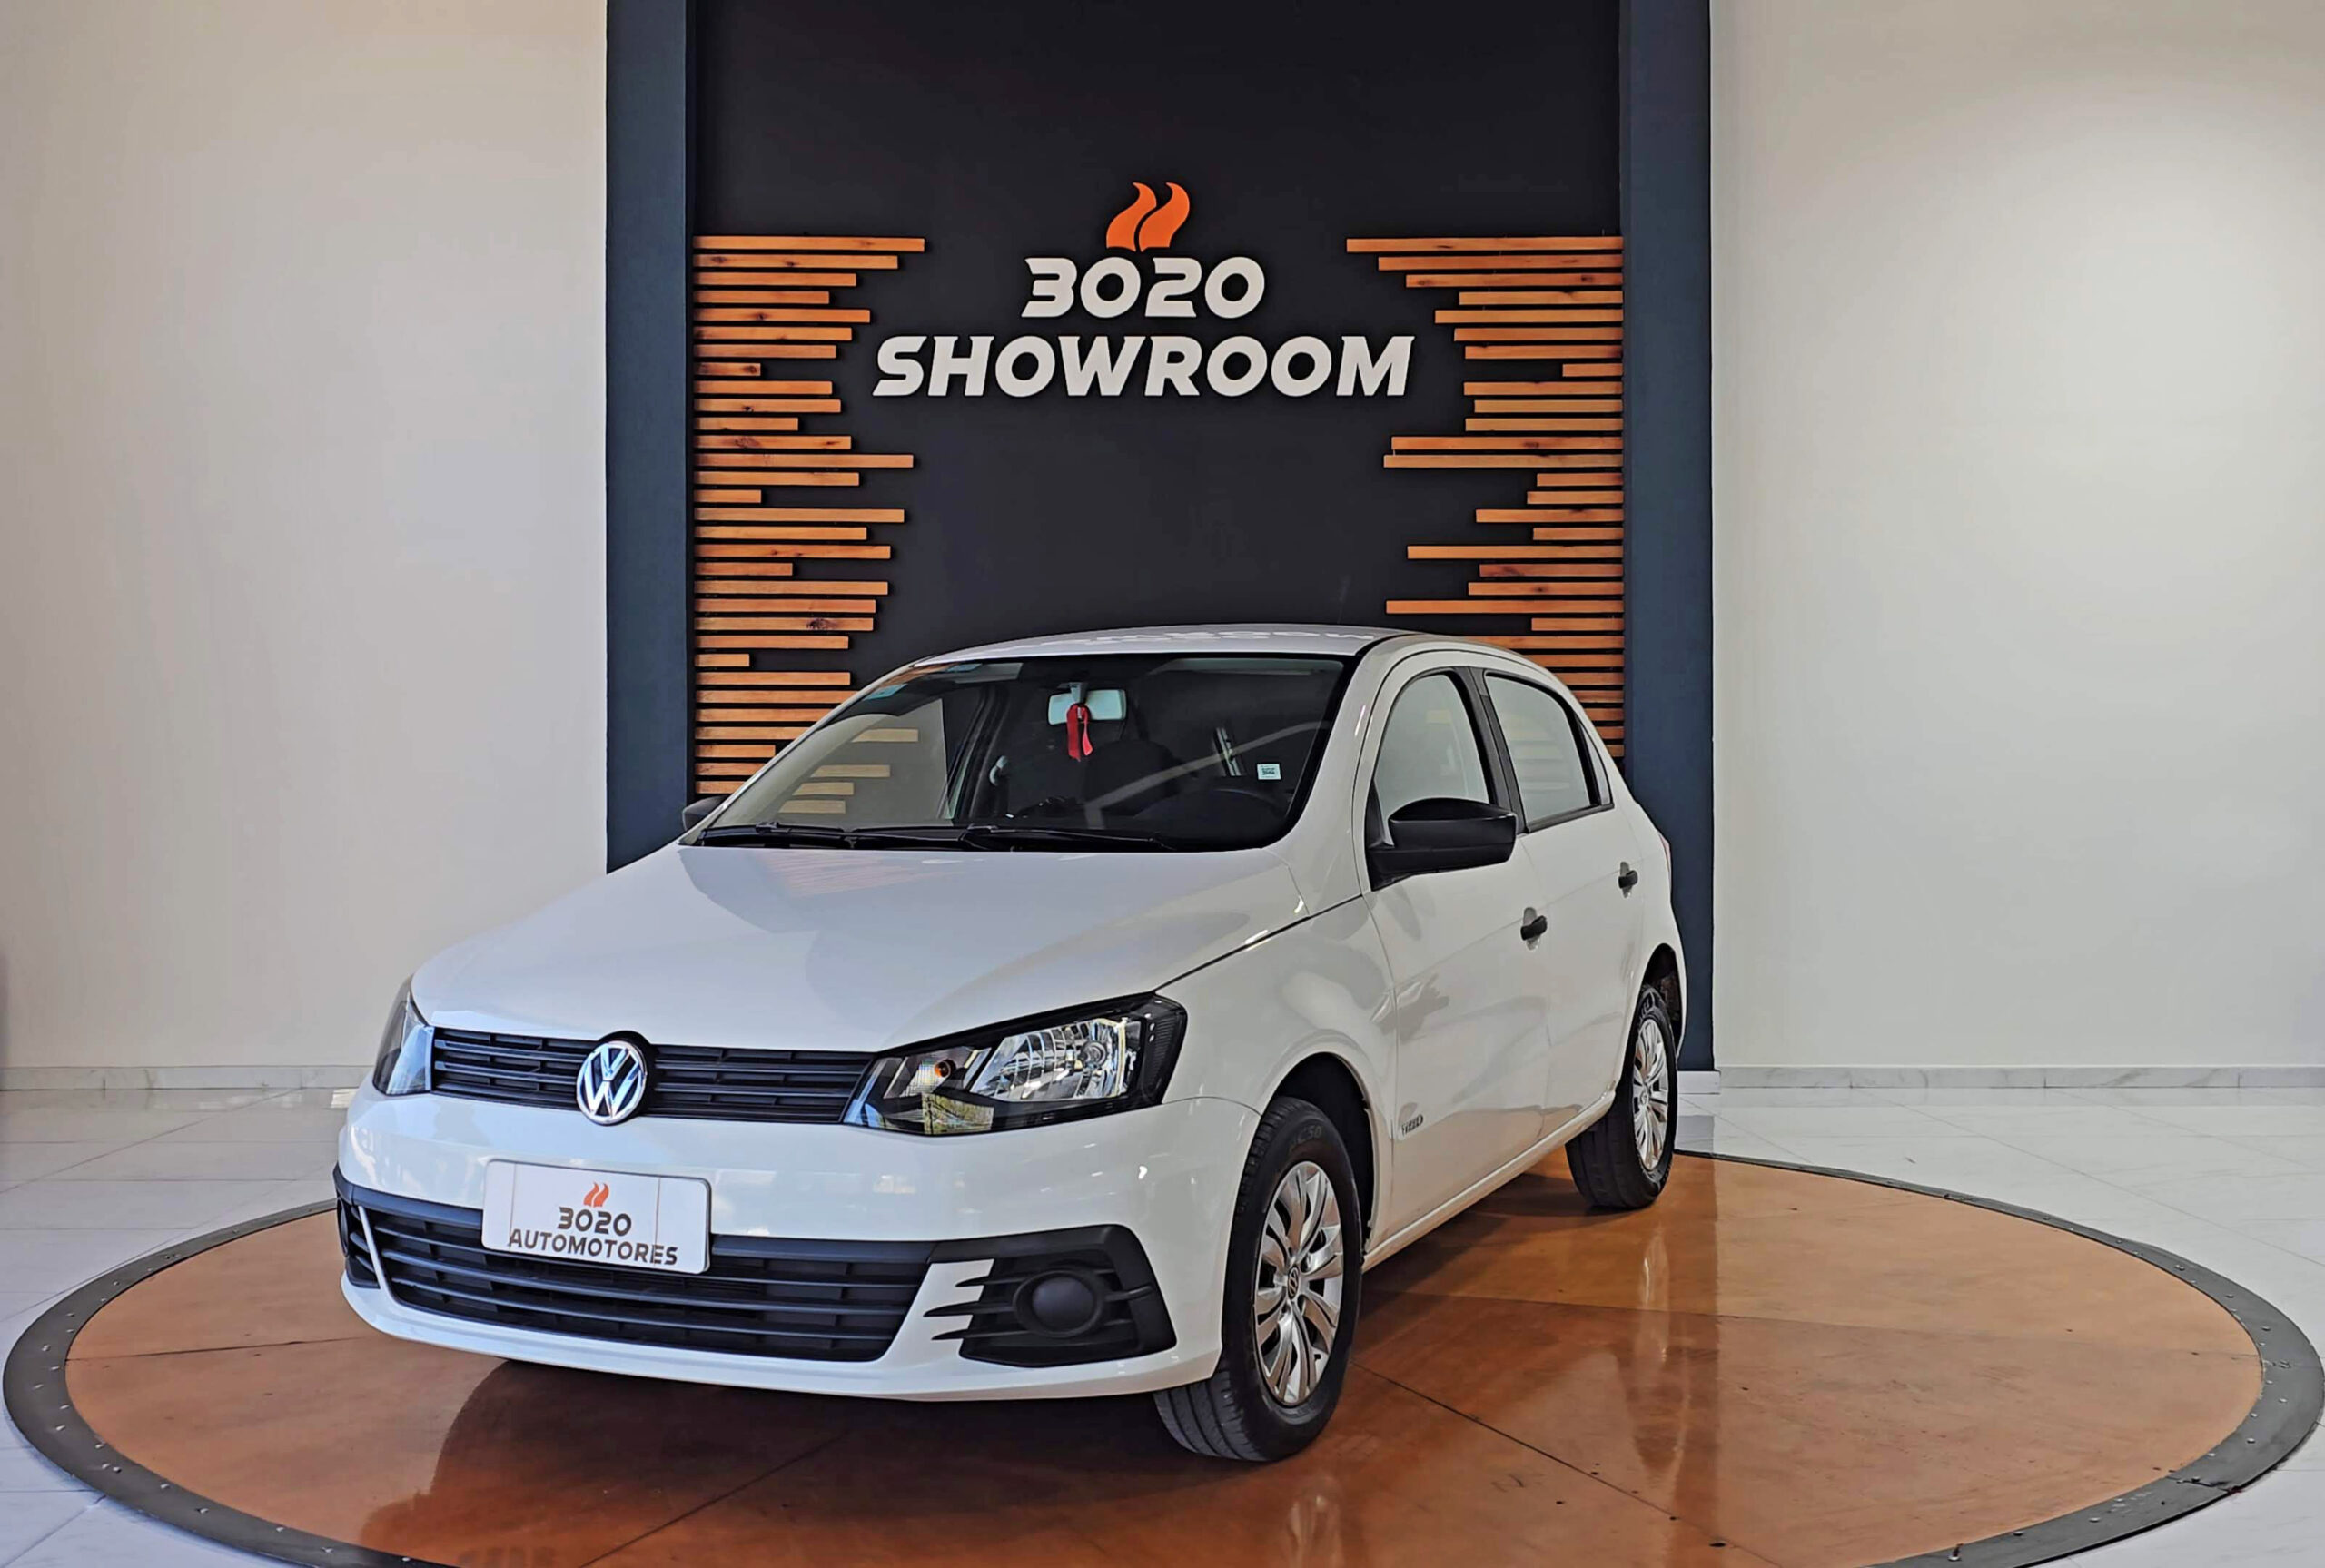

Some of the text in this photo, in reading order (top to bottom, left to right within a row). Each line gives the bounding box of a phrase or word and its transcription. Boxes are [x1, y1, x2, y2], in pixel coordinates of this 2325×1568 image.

[1022, 257, 1265, 318] 3020
[872, 335, 1415, 397] SHOWROOM
[558, 1207, 632, 1236] 3020
[508, 1228, 678, 1265] AUTOMOTORES
